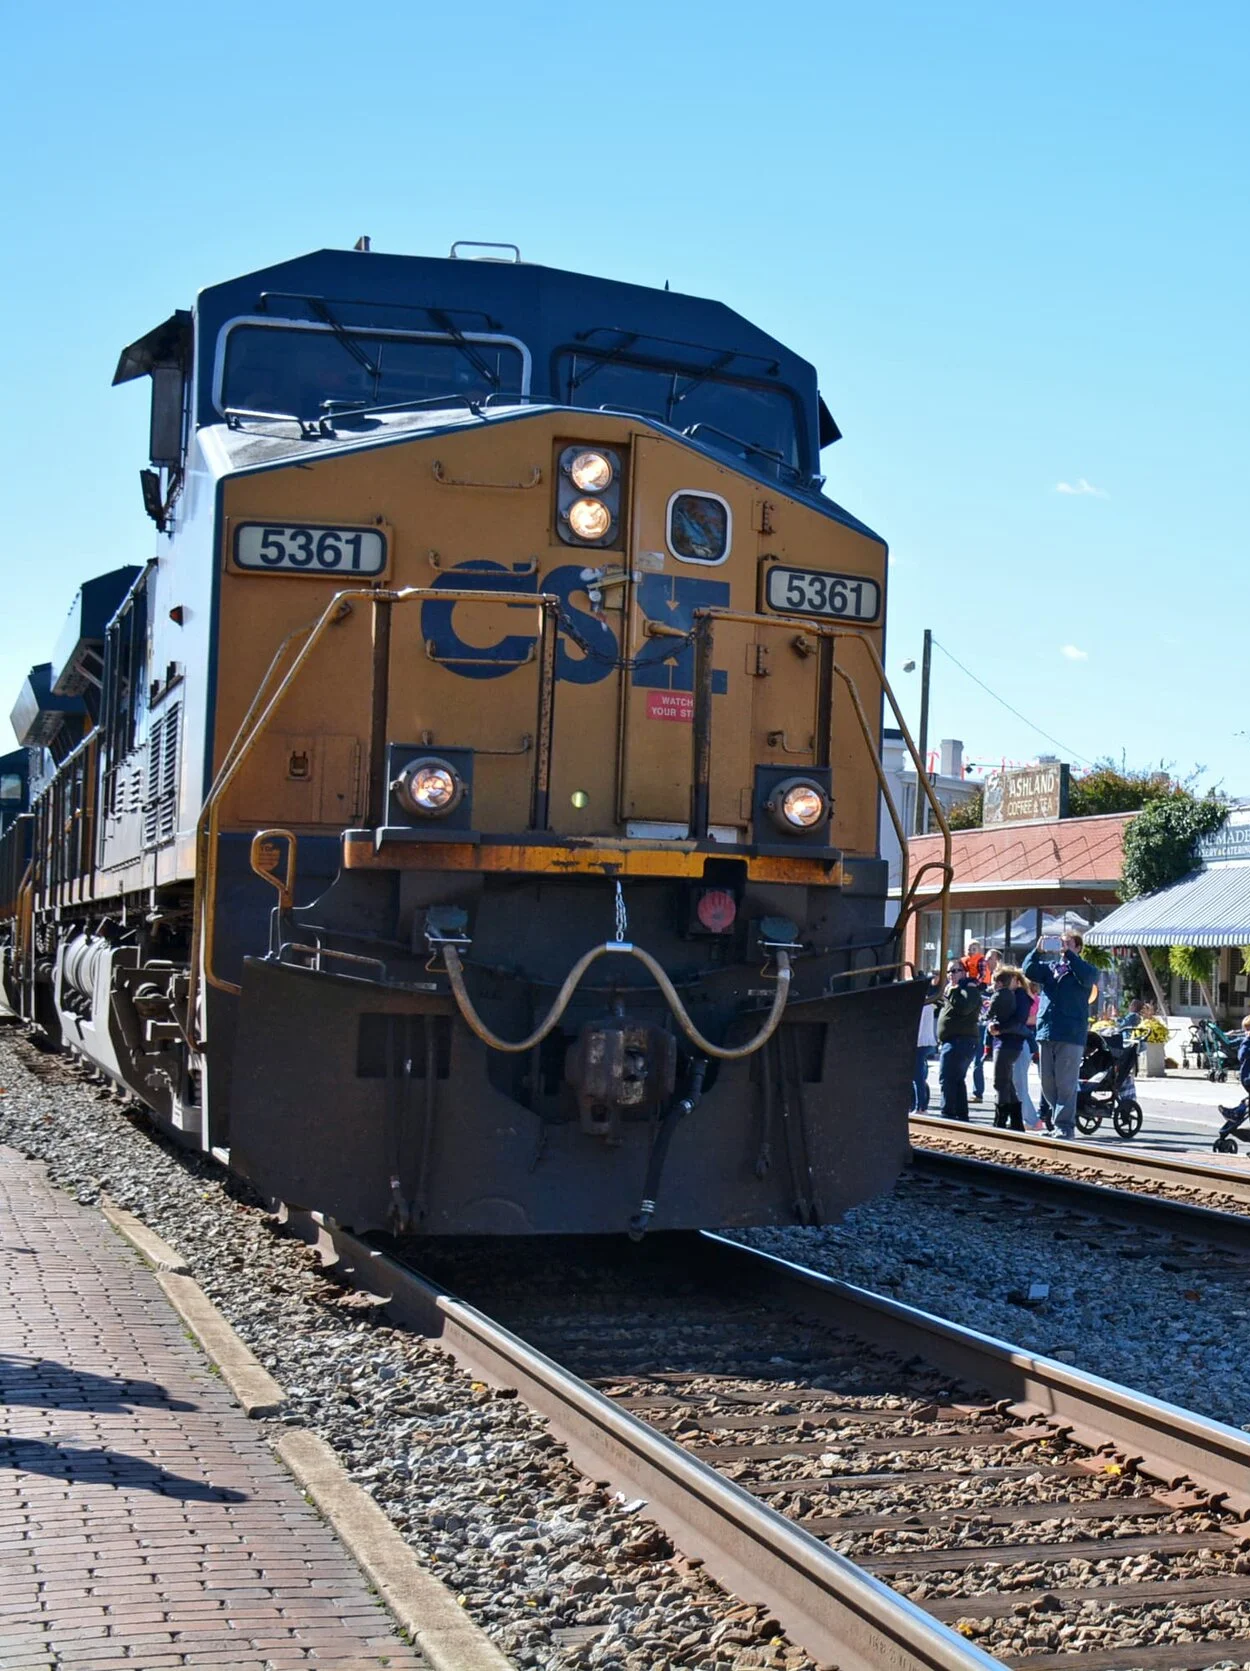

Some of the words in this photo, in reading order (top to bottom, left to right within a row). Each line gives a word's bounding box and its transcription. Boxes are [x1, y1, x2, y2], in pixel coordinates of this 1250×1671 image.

[260, 528, 362, 570] 5361
[786, 574, 863, 616] 5361
[421, 559, 731, 695] CSX
[651, 706, 677, 716] YOUR
[680, 709, 694, 718] ST
[661, 695, 693, 707] WATCH
[1009, 774, 1055, 797] ASHLAND
[1007, 799, 1032, 816] COFFEE
[1039, 797, 1053, 812] TEA
